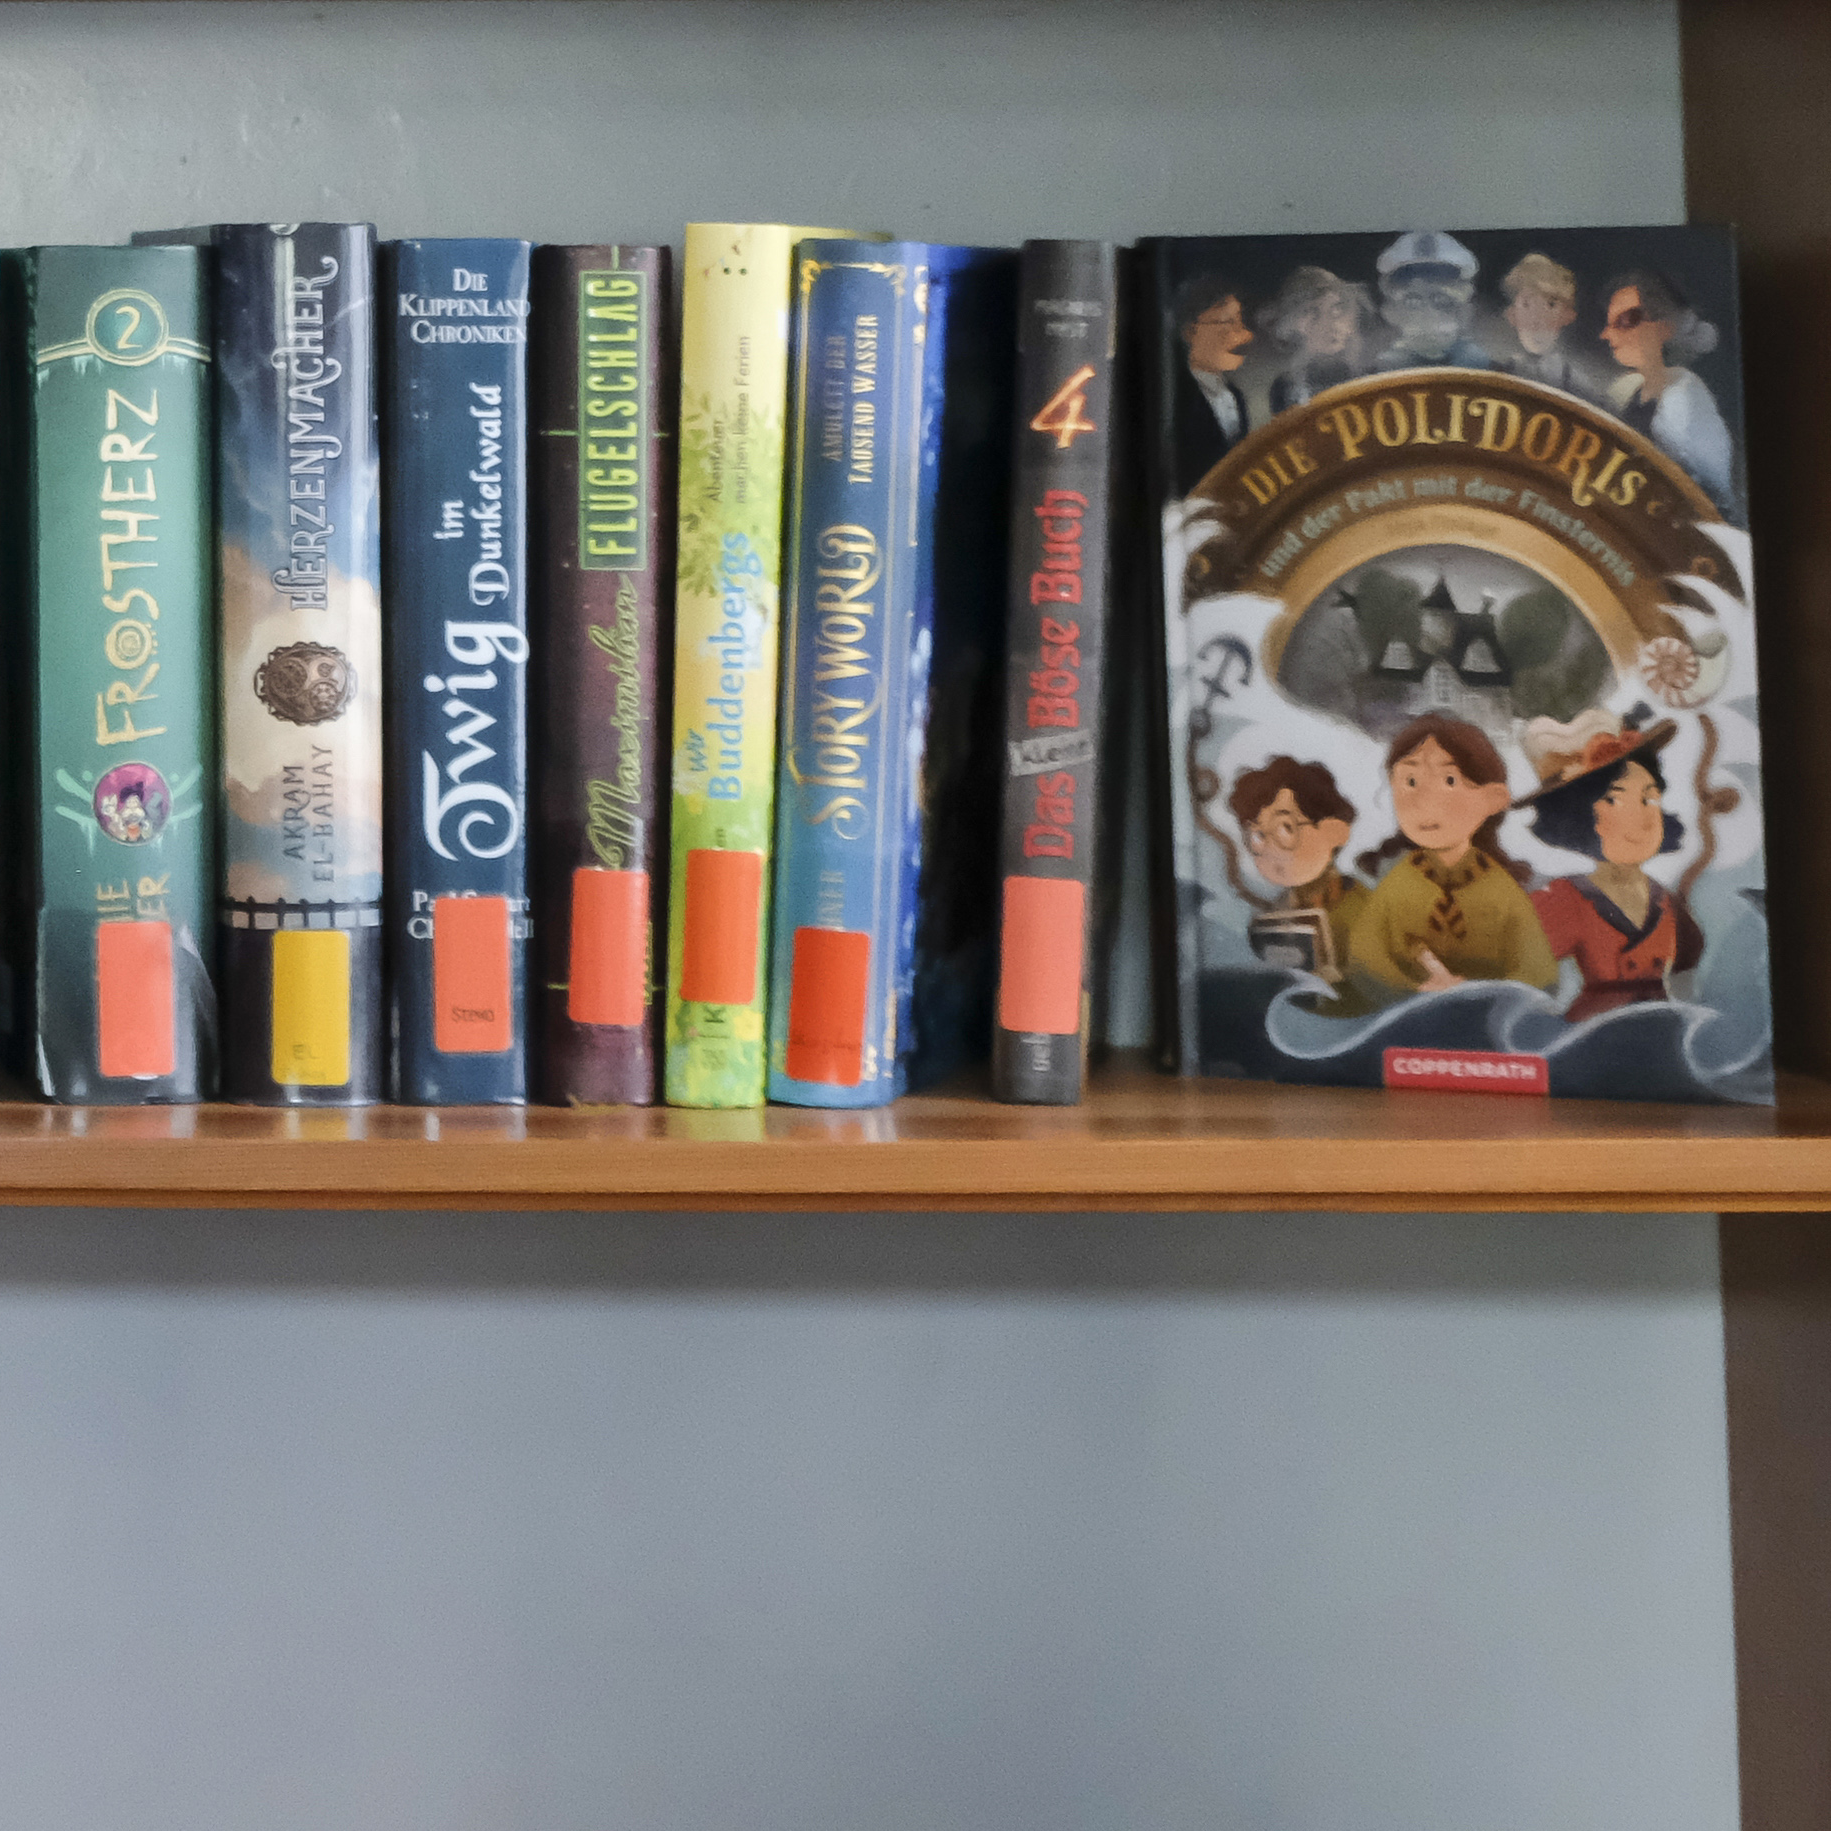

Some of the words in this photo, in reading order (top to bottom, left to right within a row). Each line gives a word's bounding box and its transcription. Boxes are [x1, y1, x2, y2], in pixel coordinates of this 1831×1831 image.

[397, 293, 532, 318] KLIPPENLAND
[450, 267, 489, 292] DIE
[408, 319, 529, 347] CHRONIKEN
[853, 313, 879, 395] WASSER
[269, 254, 345, 611] HERZENMACHER
[579, 276, 640, 557] FLÜGELSCHLAG
[847, 400, 877, 486] TAUSEND
[1028, 364, 1098, 451] 4
[1241, 436, 1320, 506] DIE
[1316, 392, 1648, 507] POLIDORIS
[467, 381, 512, 606] Dunkelwald
[706, 418, 729, 503] Abenteuer
[95, 387, 168, 745] FROSTHERZ
[432, 499, 467, 541] im
[1028, 488, 1091, 606] Buch
[706, 531, 761, 803] Buddenbergs
[1026, 617, 1082, 730] Böse
[420, 619, 531, 861] Twig
[683, 727, 710, 774] Wir
[281, 763, 309, 861] AKRAM
[309, 743, 337, 884] EL-BAHAY
[1021, 771, 1078, 860] Das
